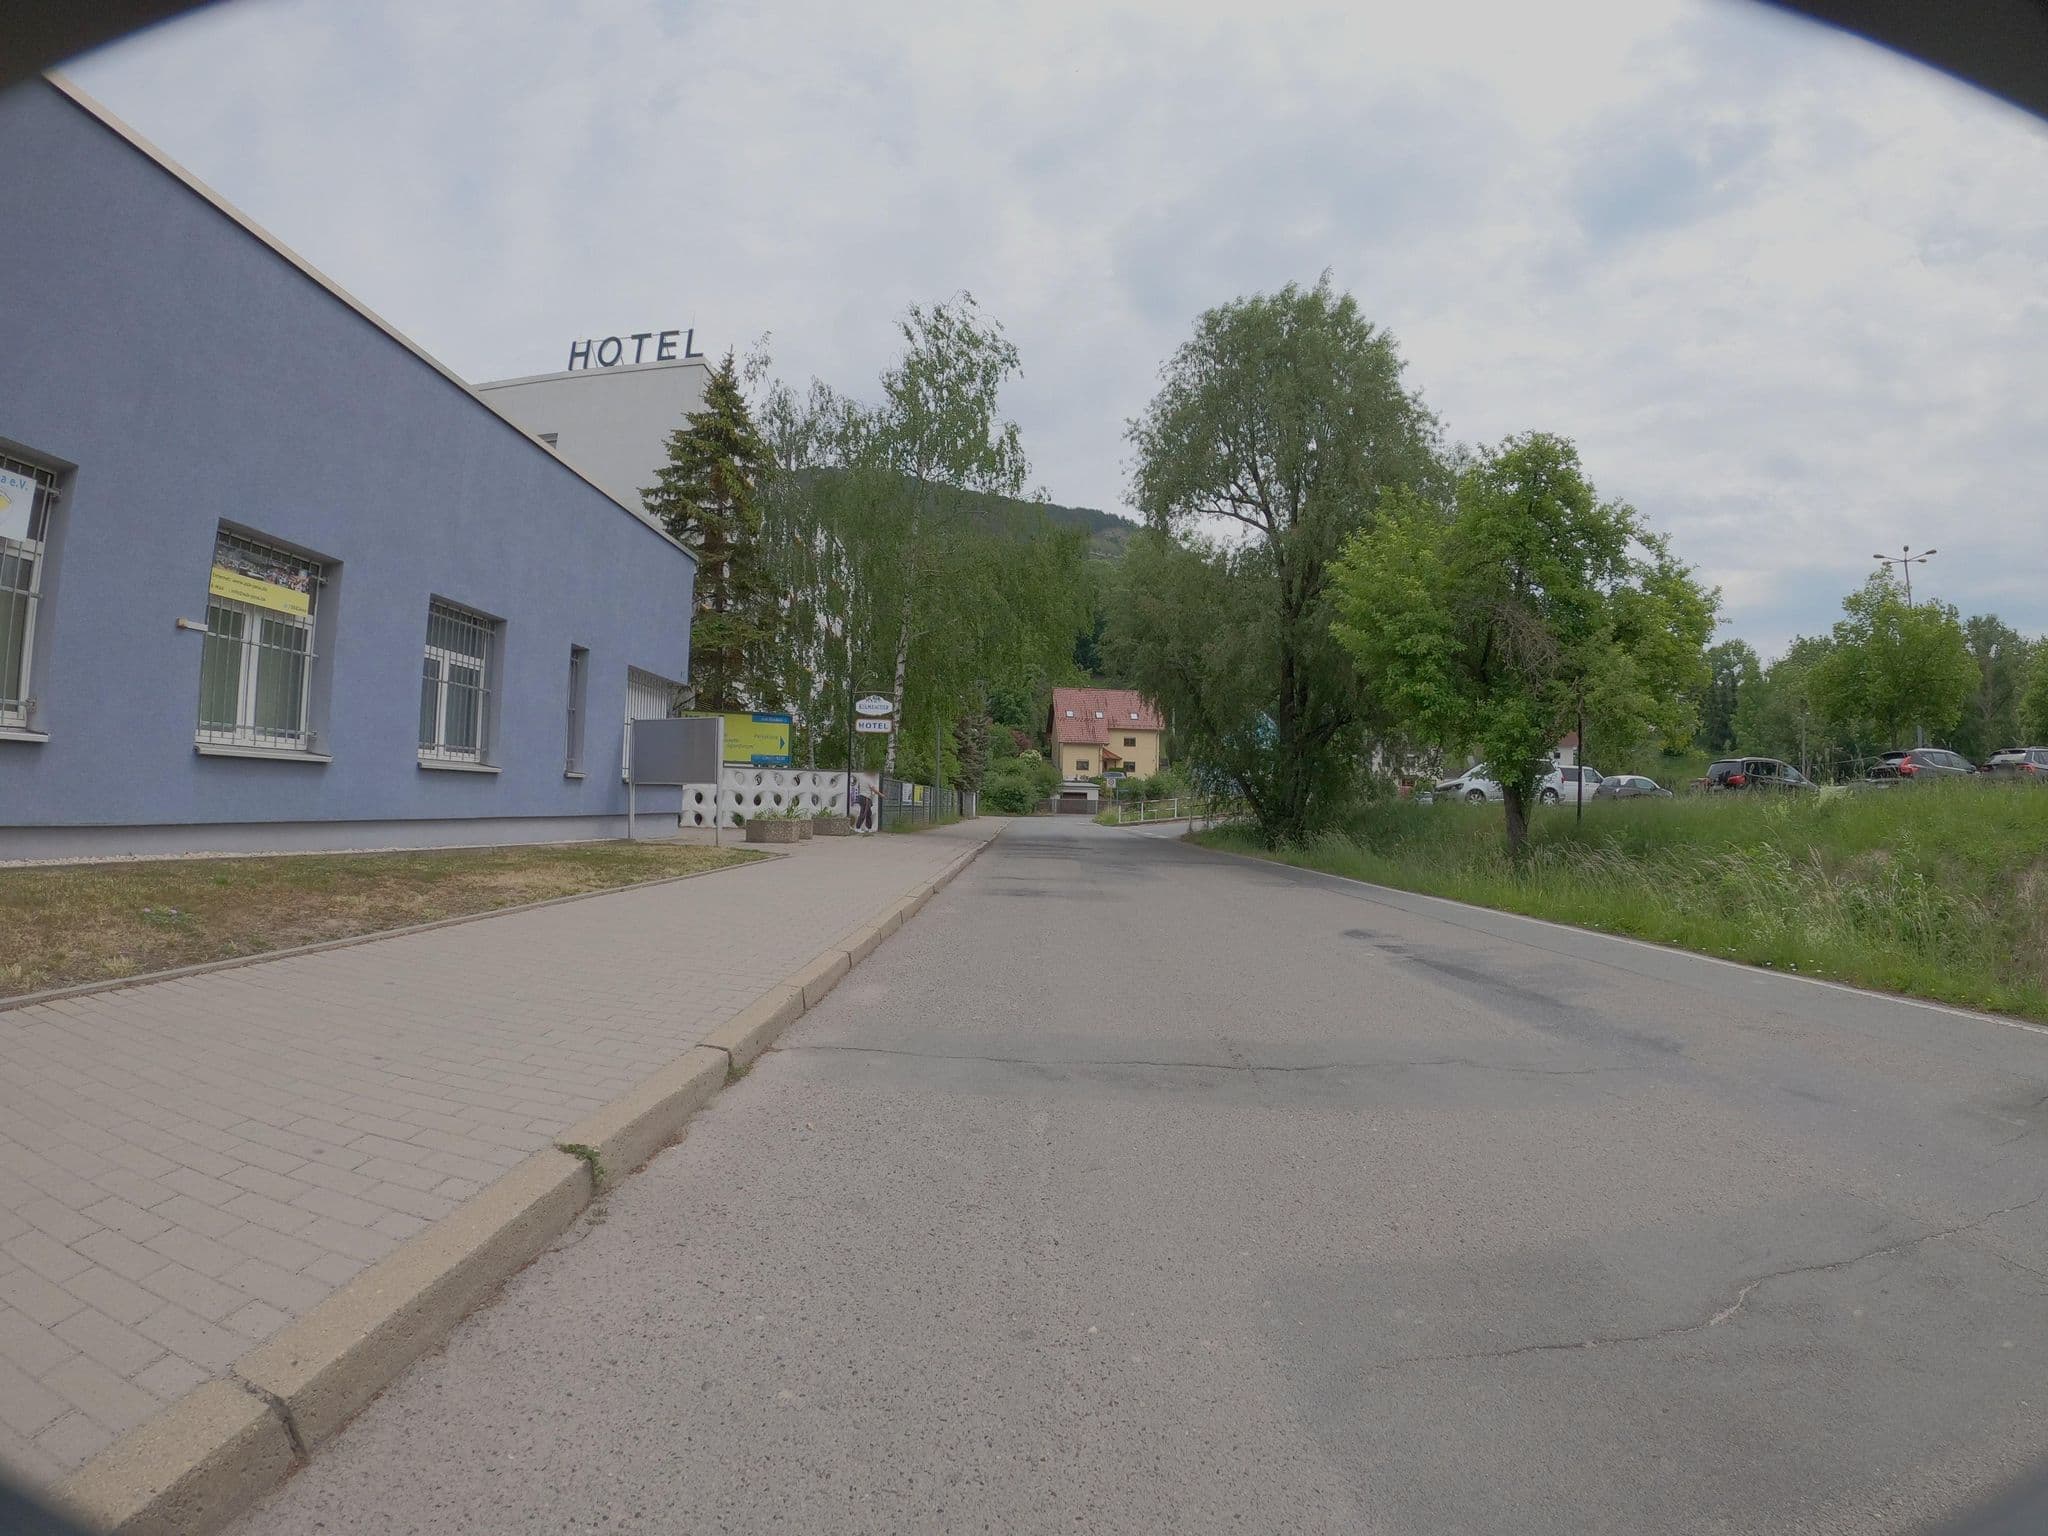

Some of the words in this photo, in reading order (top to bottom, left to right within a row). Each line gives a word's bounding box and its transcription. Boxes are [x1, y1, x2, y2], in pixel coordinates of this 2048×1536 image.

[568, 328, 704, 371] HOTEL
[9, 478, 29, 491] e.V.
[858, 722, 889, 730] HOTEL
